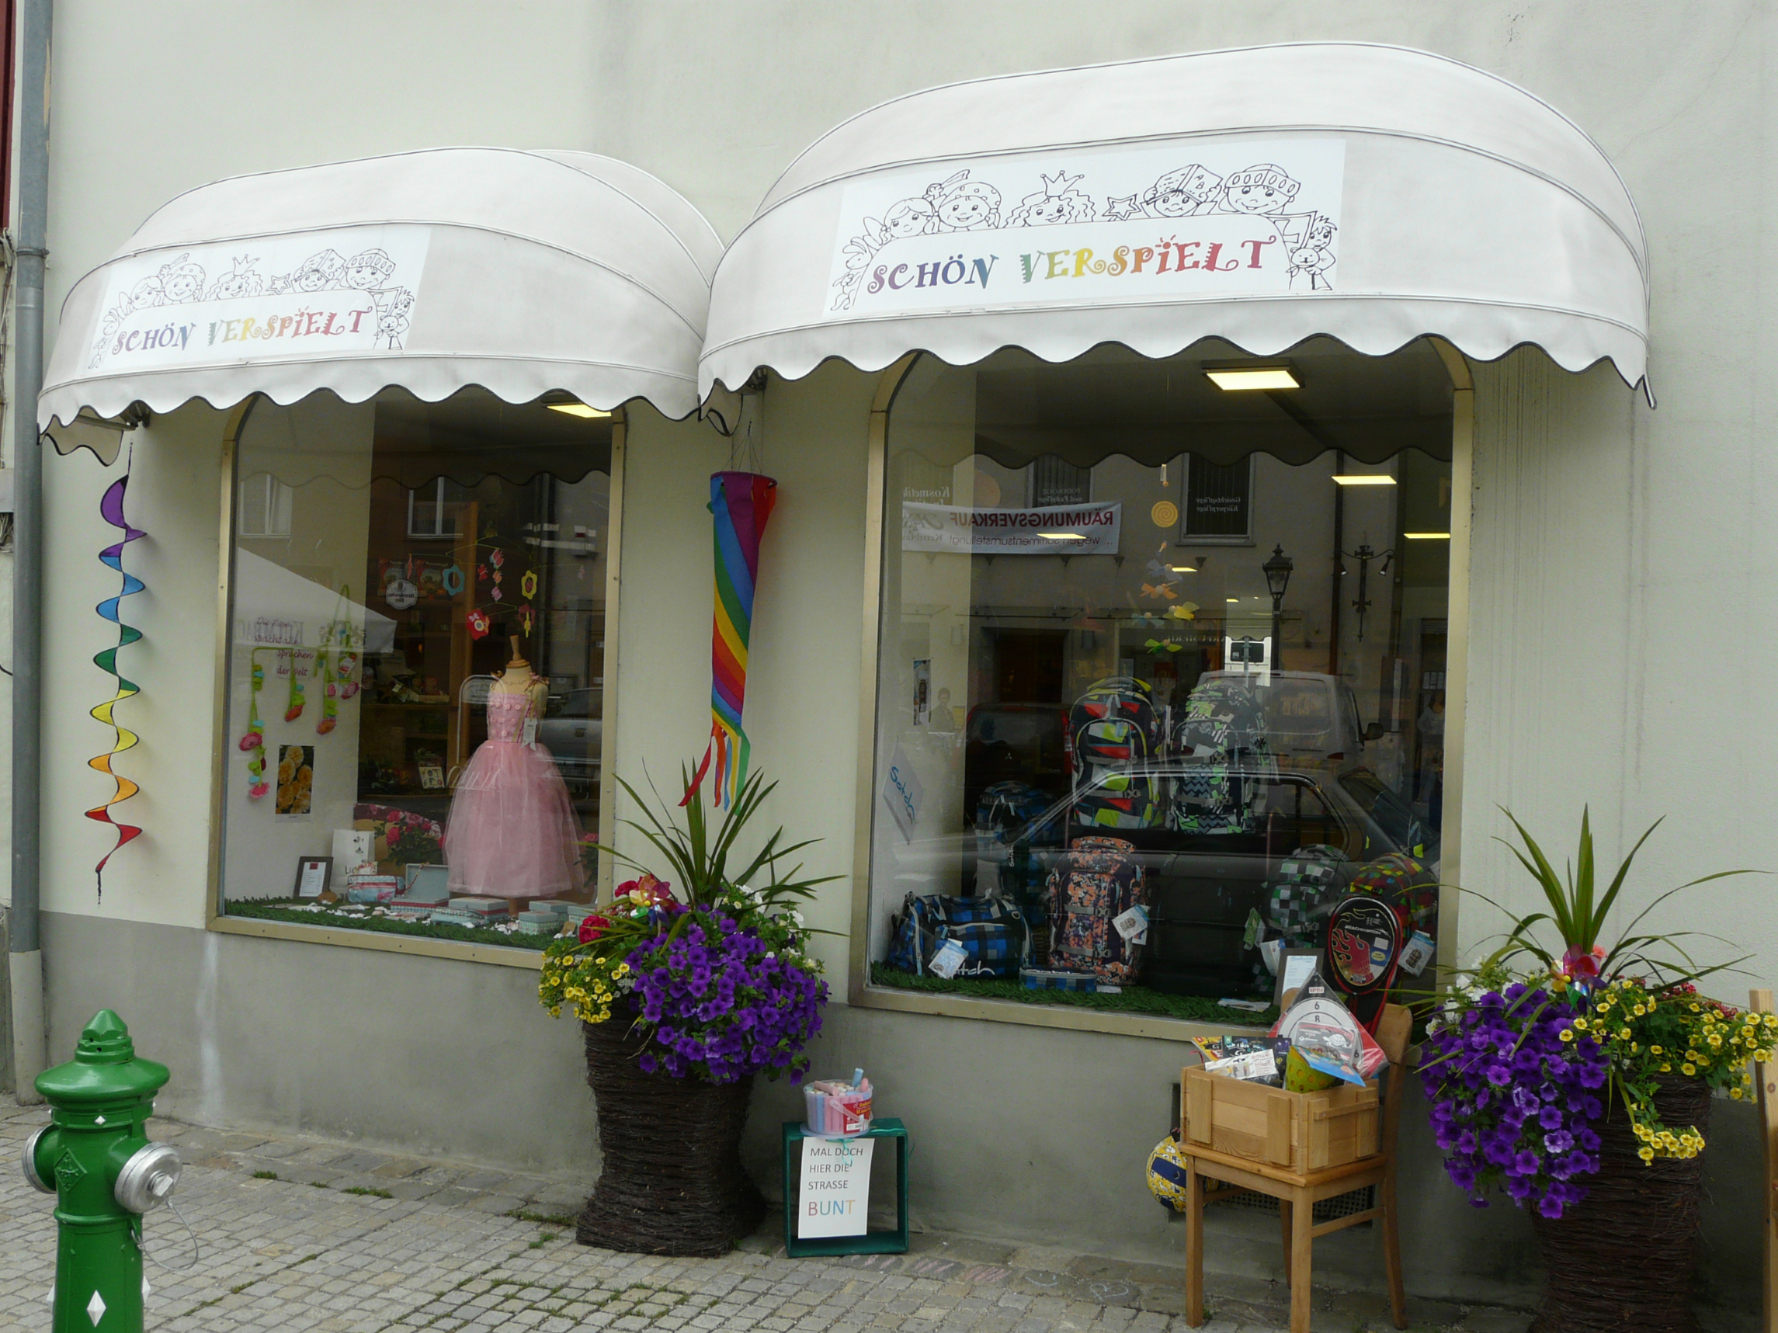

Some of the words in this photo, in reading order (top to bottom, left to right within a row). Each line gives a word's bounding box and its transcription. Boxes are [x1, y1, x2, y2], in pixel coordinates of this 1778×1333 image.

[867, 254, 1000, 294] SCHÖN
[111, 322, 197, 356] SCHÖN
[276, 665, 290, 675] der
[810, 1147, 832, 1157] MAL
[835, 1147, 864, 1157] DOCH
[809, 1164, 831, 1174] HIER
[834, 1163, 850, 1173] DIE
[808, 1180, 849, 1190] STRASSE
[808, 1200, 856, 1216] BUNT
